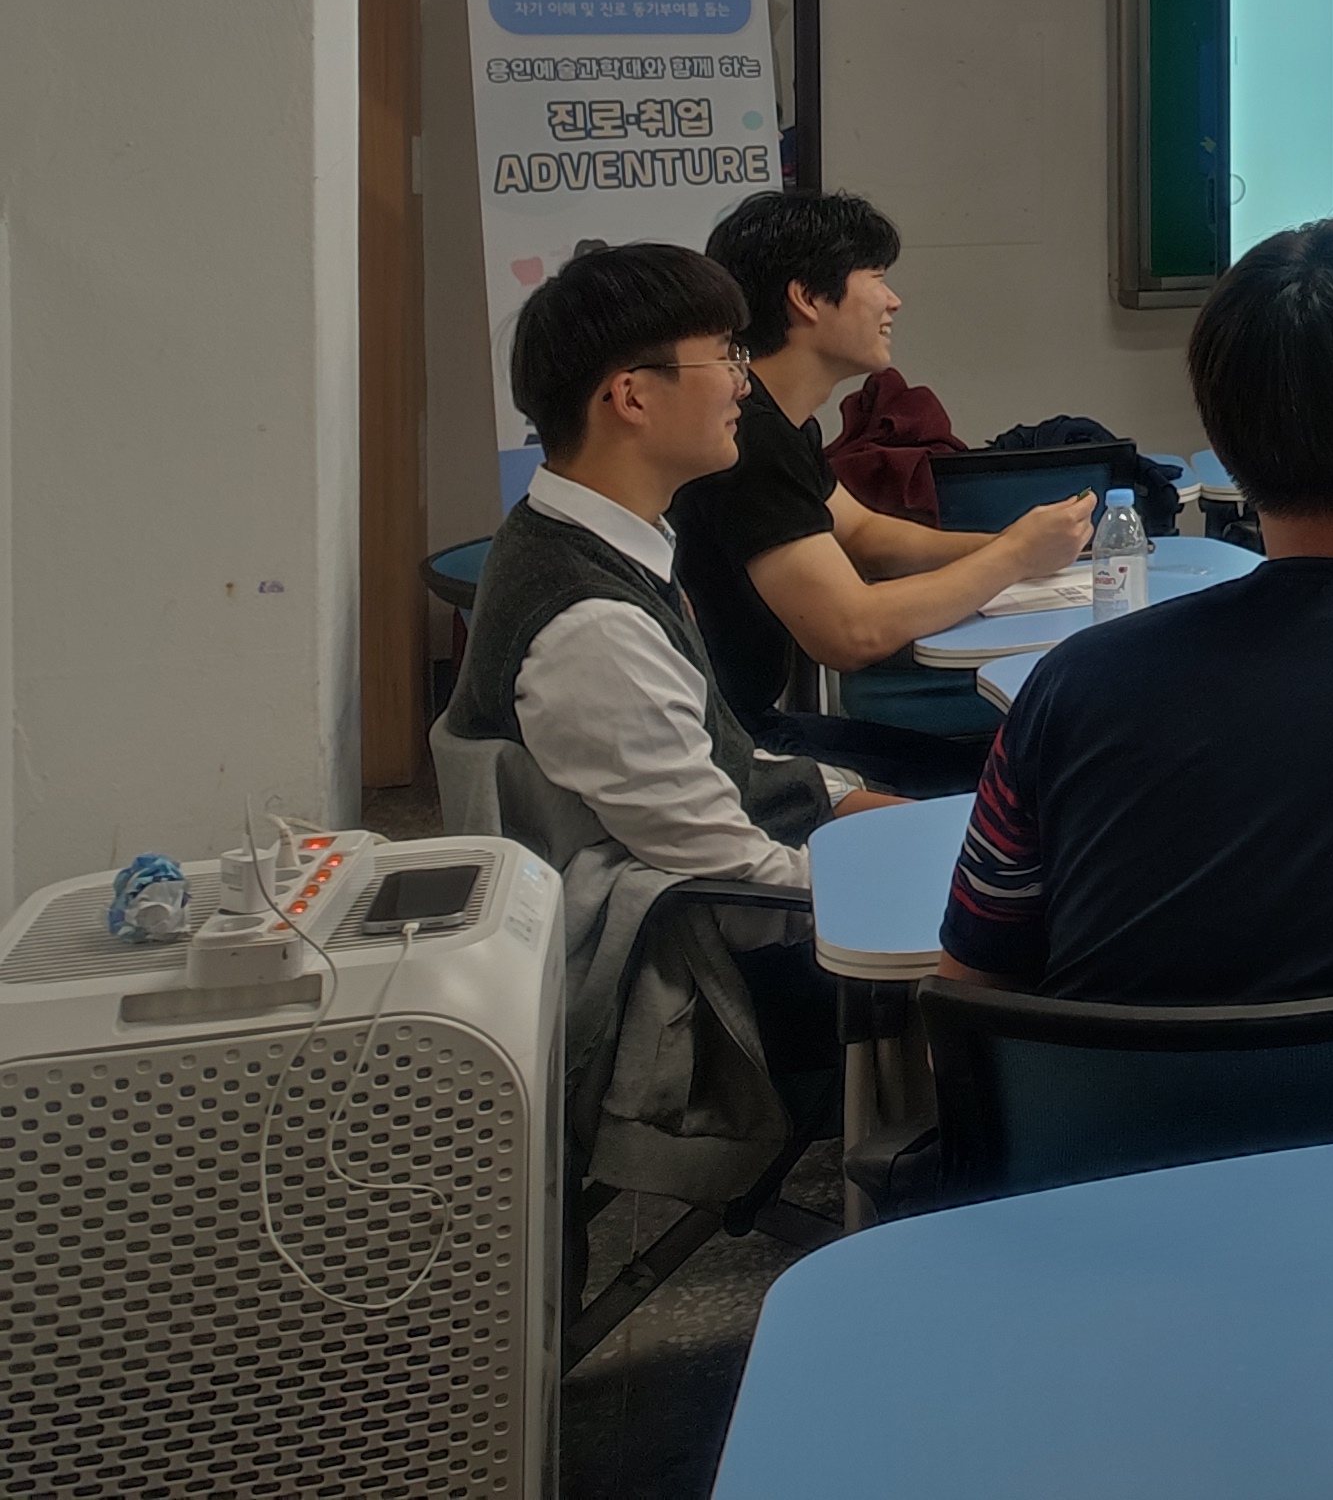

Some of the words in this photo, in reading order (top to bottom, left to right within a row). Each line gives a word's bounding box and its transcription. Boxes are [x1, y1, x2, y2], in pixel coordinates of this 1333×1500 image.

[514, 1, 543, 17] 자기
[547, 1, 577, 17] 이해
[580, 1, 594, 18] 및
[599, 1, 629, 18] 진로
[632, 1, 700, 18] 동기부여를
[704, 1, 730, 18] 돕는
[486, 56, 666, 83] 용인예술과학대와
[669, 55, 715, 80] 함께
[718, 55, 761, 79] 하는
[547, 98, 713, 141] 진로·취업
[493, 145, 770, 194] ADVENTURE
